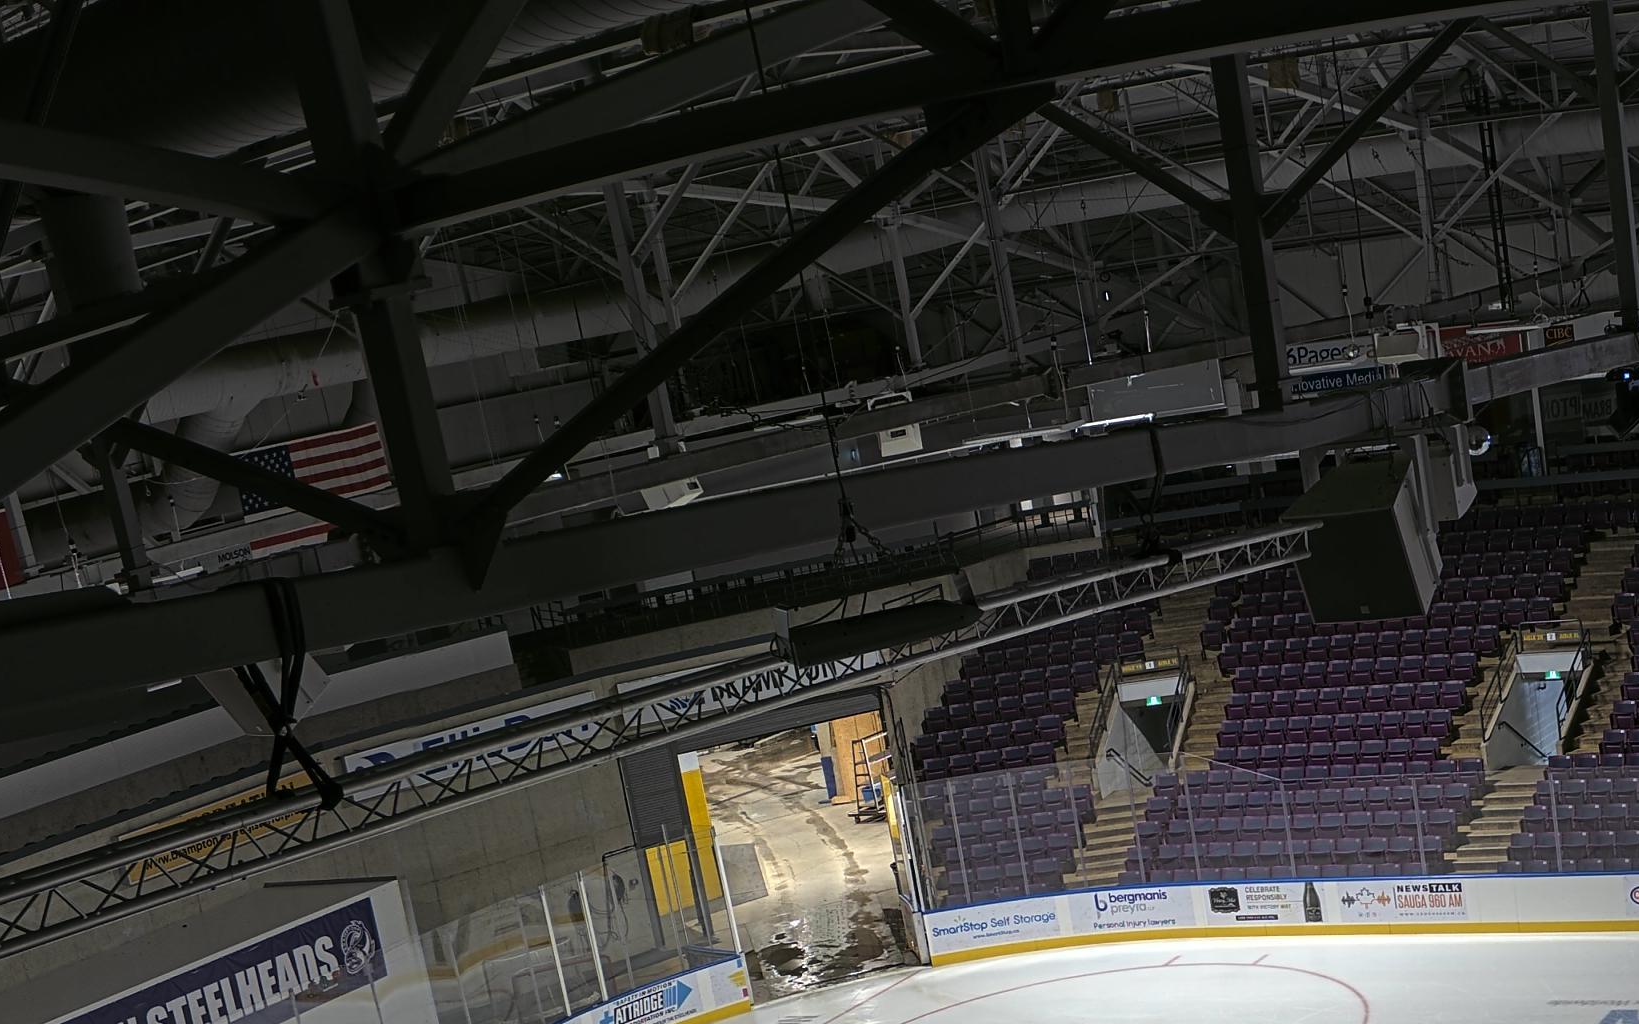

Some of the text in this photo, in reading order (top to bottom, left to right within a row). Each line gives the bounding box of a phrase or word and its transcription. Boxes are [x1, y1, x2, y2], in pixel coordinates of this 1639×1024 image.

[1545, 327, 1573, 340] CIBC
[1244, 885, 1281, 893] CELEBRATE
[1396, 883, 1461, 892] NEWS TALK
[1109, 889, 1167, 903] bergmanis
[1397, 893, 1462, 908] SAUGA 960 AM
[1110, 903, 1147, 915] preyra
[932, 911, 1055, 937] SmartStop Self Storage
[1093, 921, 1125, 929] Personal
